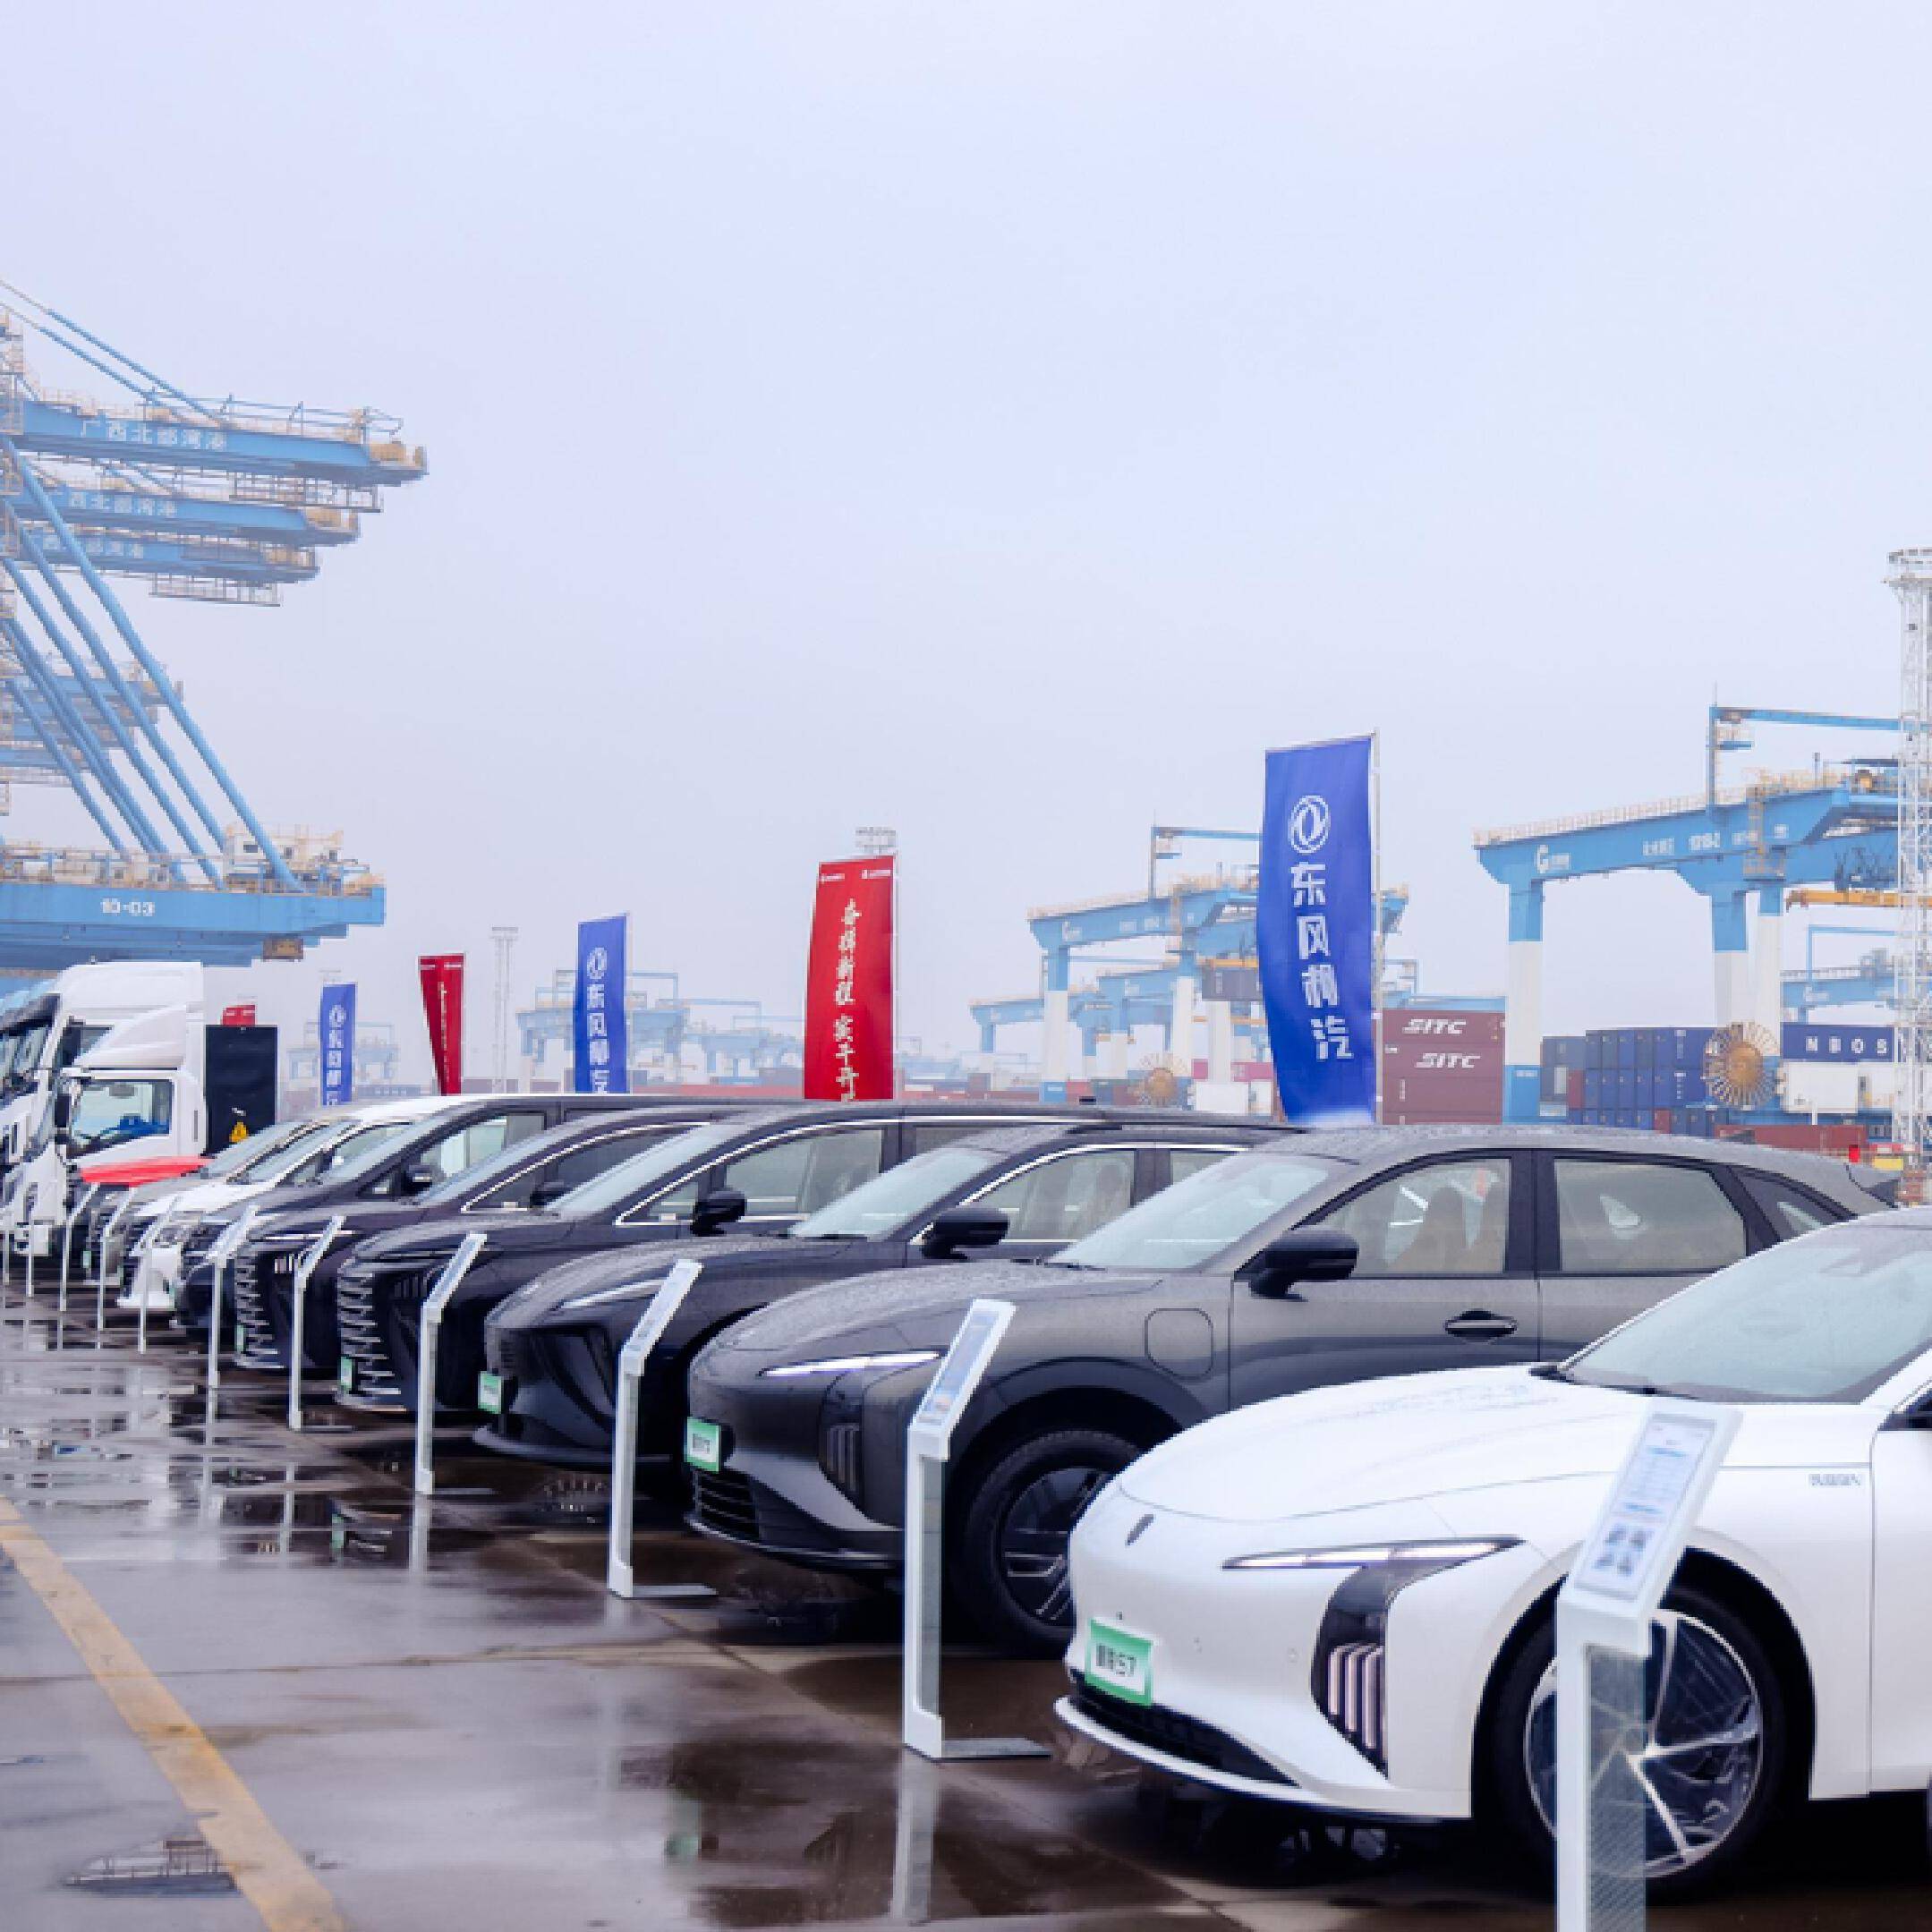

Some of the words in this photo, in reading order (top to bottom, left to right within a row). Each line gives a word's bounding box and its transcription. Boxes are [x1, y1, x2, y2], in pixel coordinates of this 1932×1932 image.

[1289, 861, 1354, 1062] 东风柳汽
[1402, 1017, 1468, 1035] SITC
[1414, 1052, 1482, 1069] SITC
